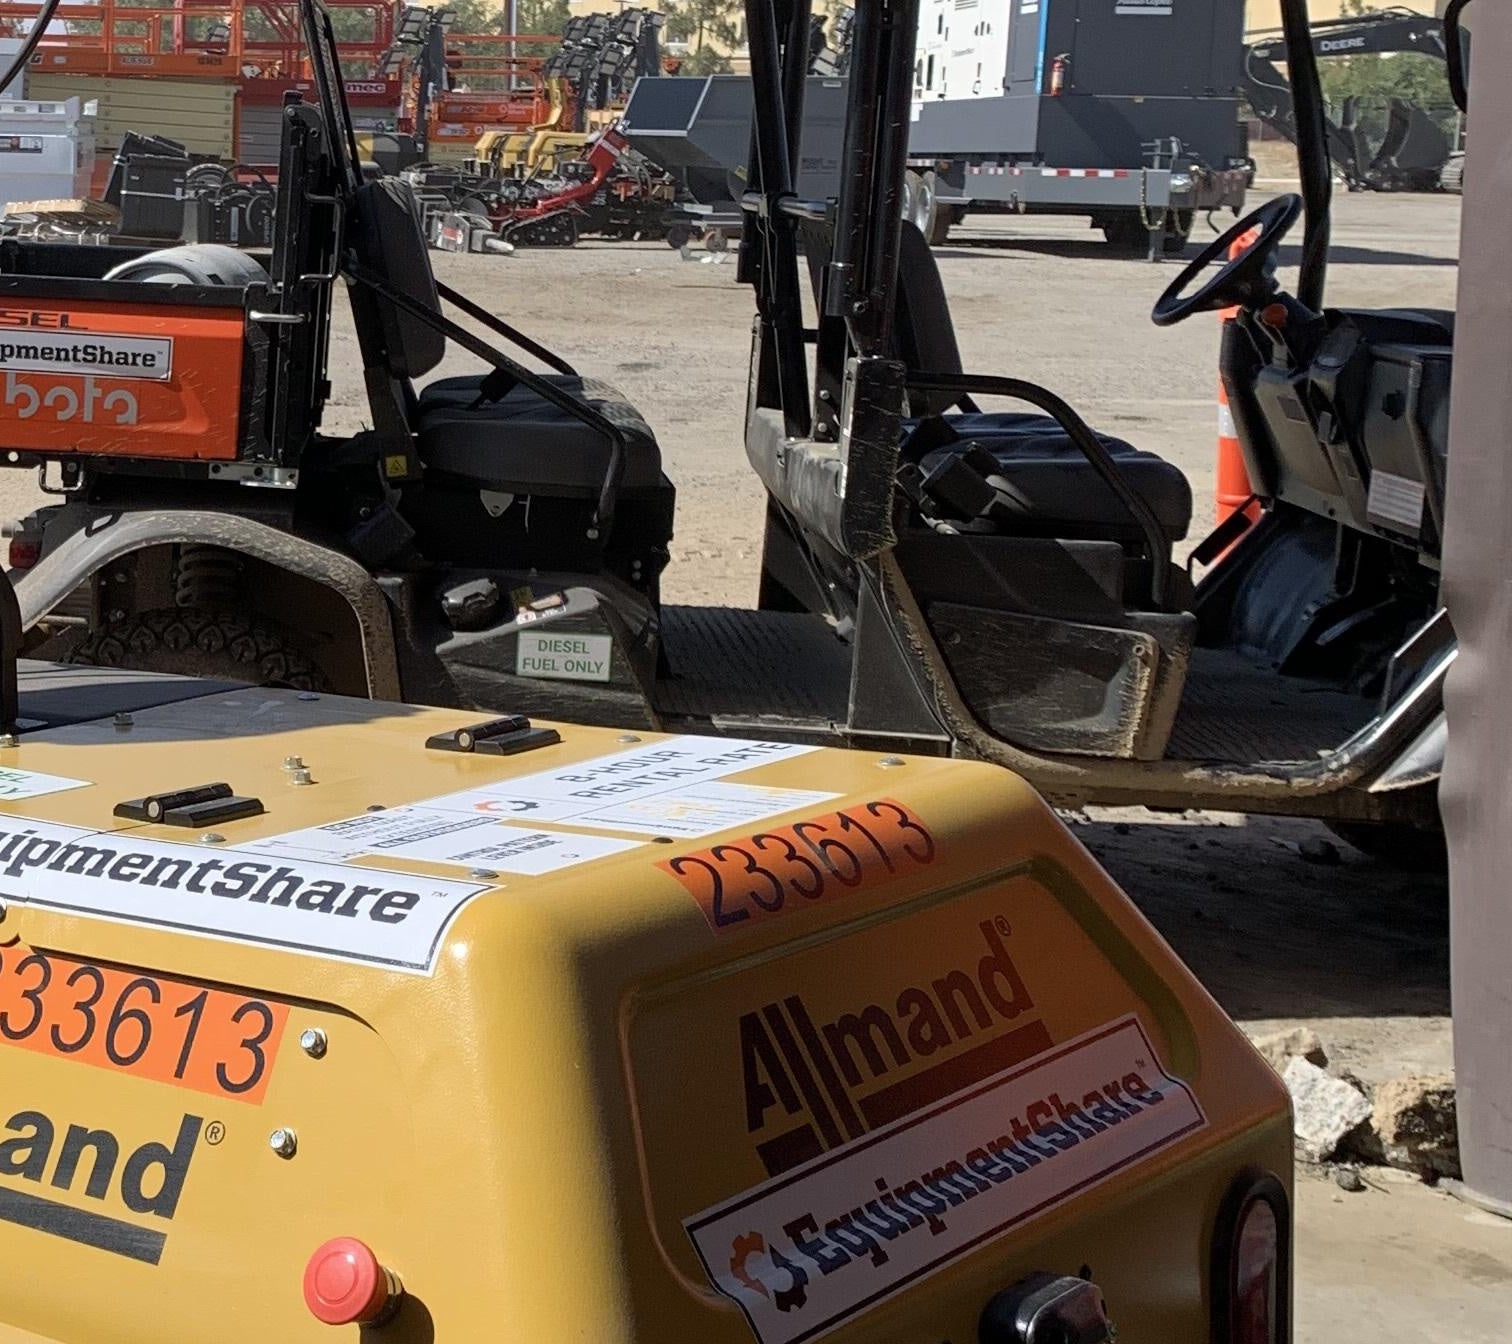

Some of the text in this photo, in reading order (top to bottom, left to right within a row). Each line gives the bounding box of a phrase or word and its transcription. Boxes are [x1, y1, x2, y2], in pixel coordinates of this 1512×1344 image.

[523, 658, 603, 674] FUEL ONLY
[538, 640, 589, 654] DIESEL
[555, 750, 693, 783] 8-HOUR
[569, 743, 793, 799] RENTAL RATE
[669, 801, 936, 926] 233613
[737, 920, 1033, 1146] Allmand
[782, 1072, 1165, 1277] EquipmentShare
